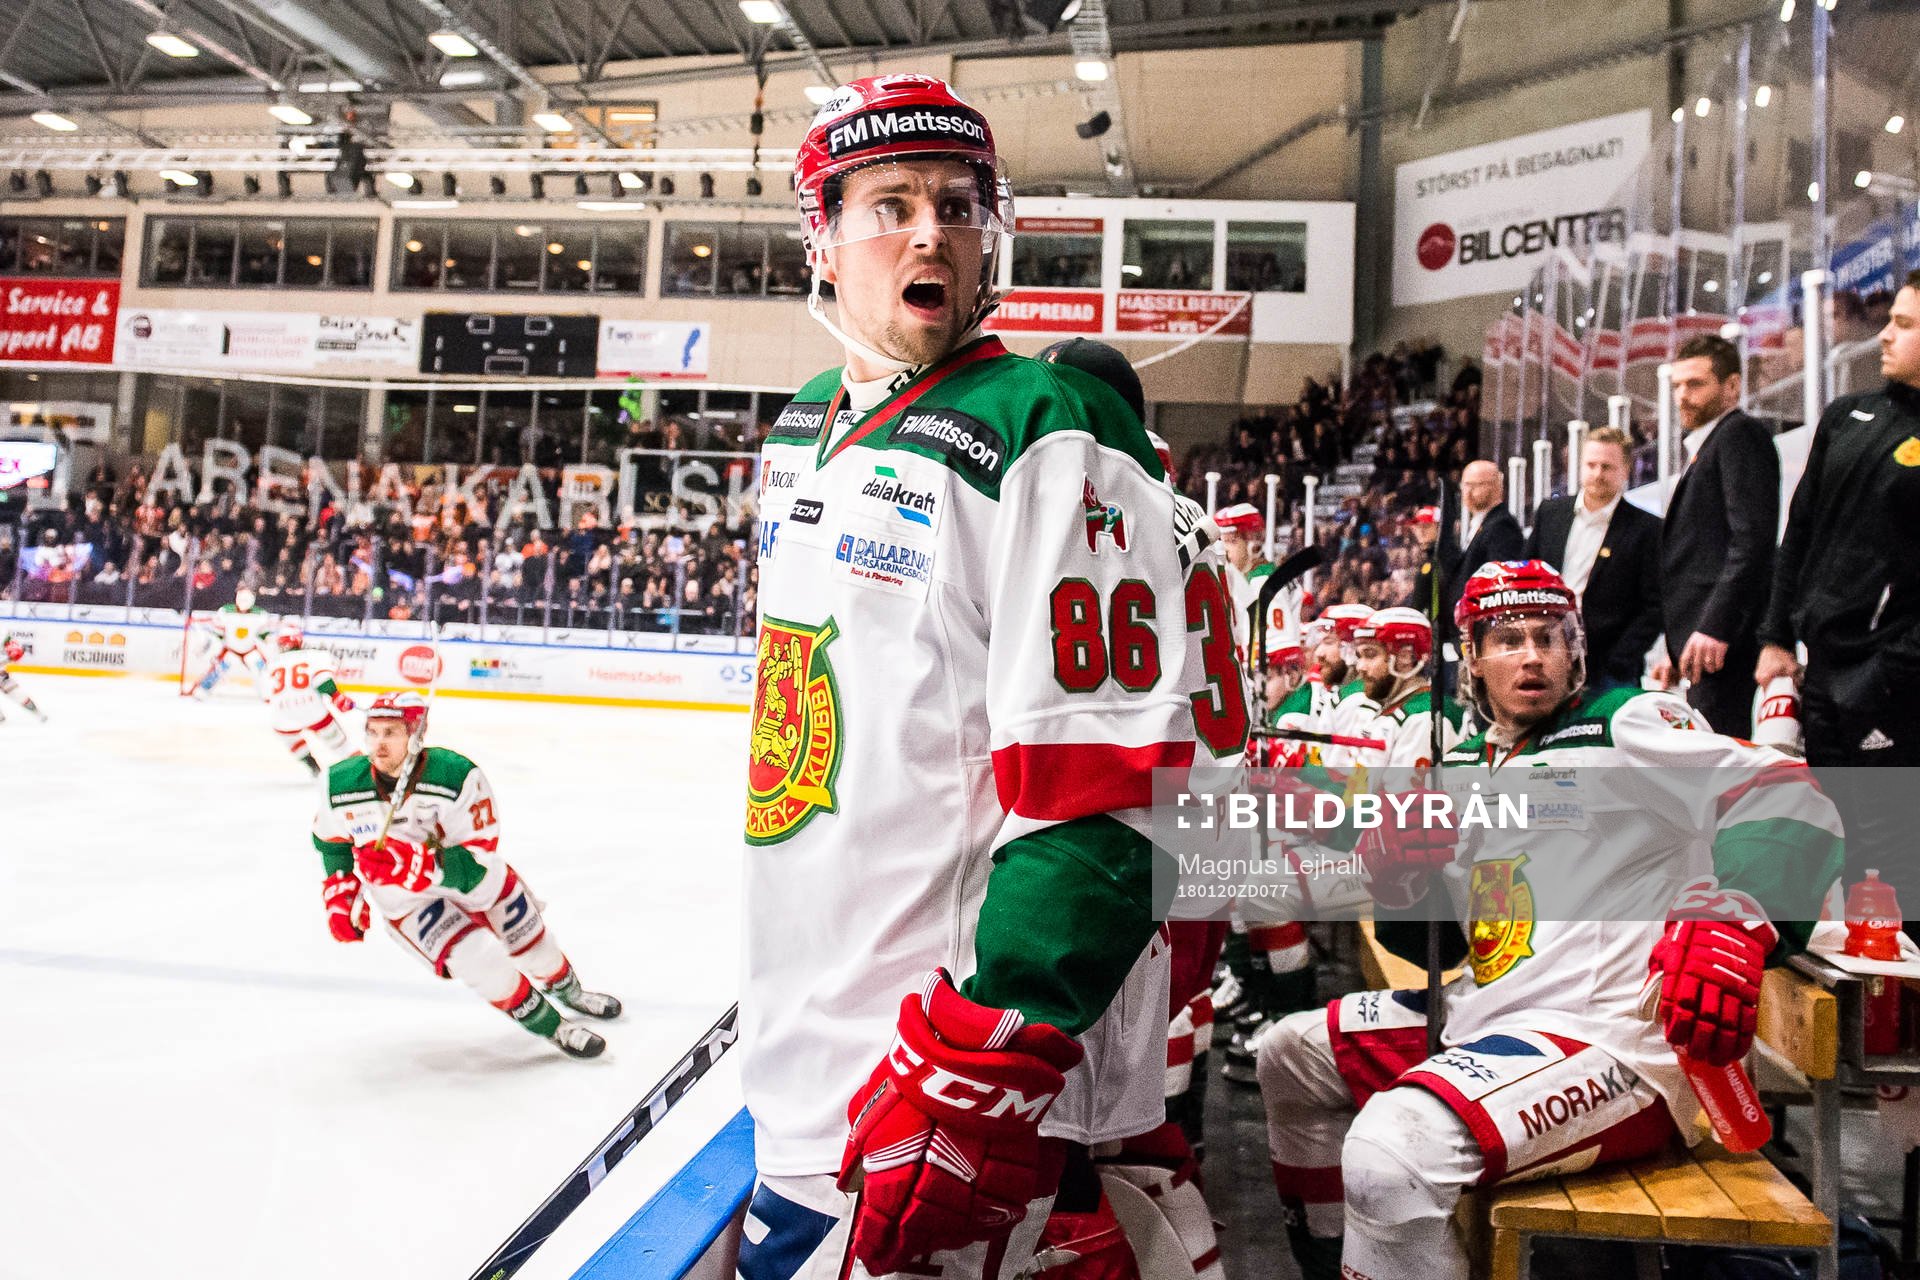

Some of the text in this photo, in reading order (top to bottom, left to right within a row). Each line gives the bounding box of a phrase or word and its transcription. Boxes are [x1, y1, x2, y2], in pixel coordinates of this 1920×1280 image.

[829, 111, 986, 153] FM Mattsson
[1415, 166, 1481, 199] STÖRST
[6, 286, 110, 316] Service &
[60, 323, 103, 354] AB
[836, 411, 857, 426] SHL
[914, 414, 999, 472] Mattsson
[146, 437, 413, 533] ARENA
[861, 477, 937, 515] dalakraft
[854, 537, 932, 575] DALARNAS
[1479, 589, 1570, 611] FM Mattsson
[1049, 576, 1163, 694] 86
[270, 662, 310, 695] 36
[588, 666, 684, 686] Heimstaden
[804, 687, 831, 786] KLUBB
[467, 797, 497, 832] 27
[887, 1022, 1056, 1123] CCM
[1517, 1065, 1641, 1140] MORAK
